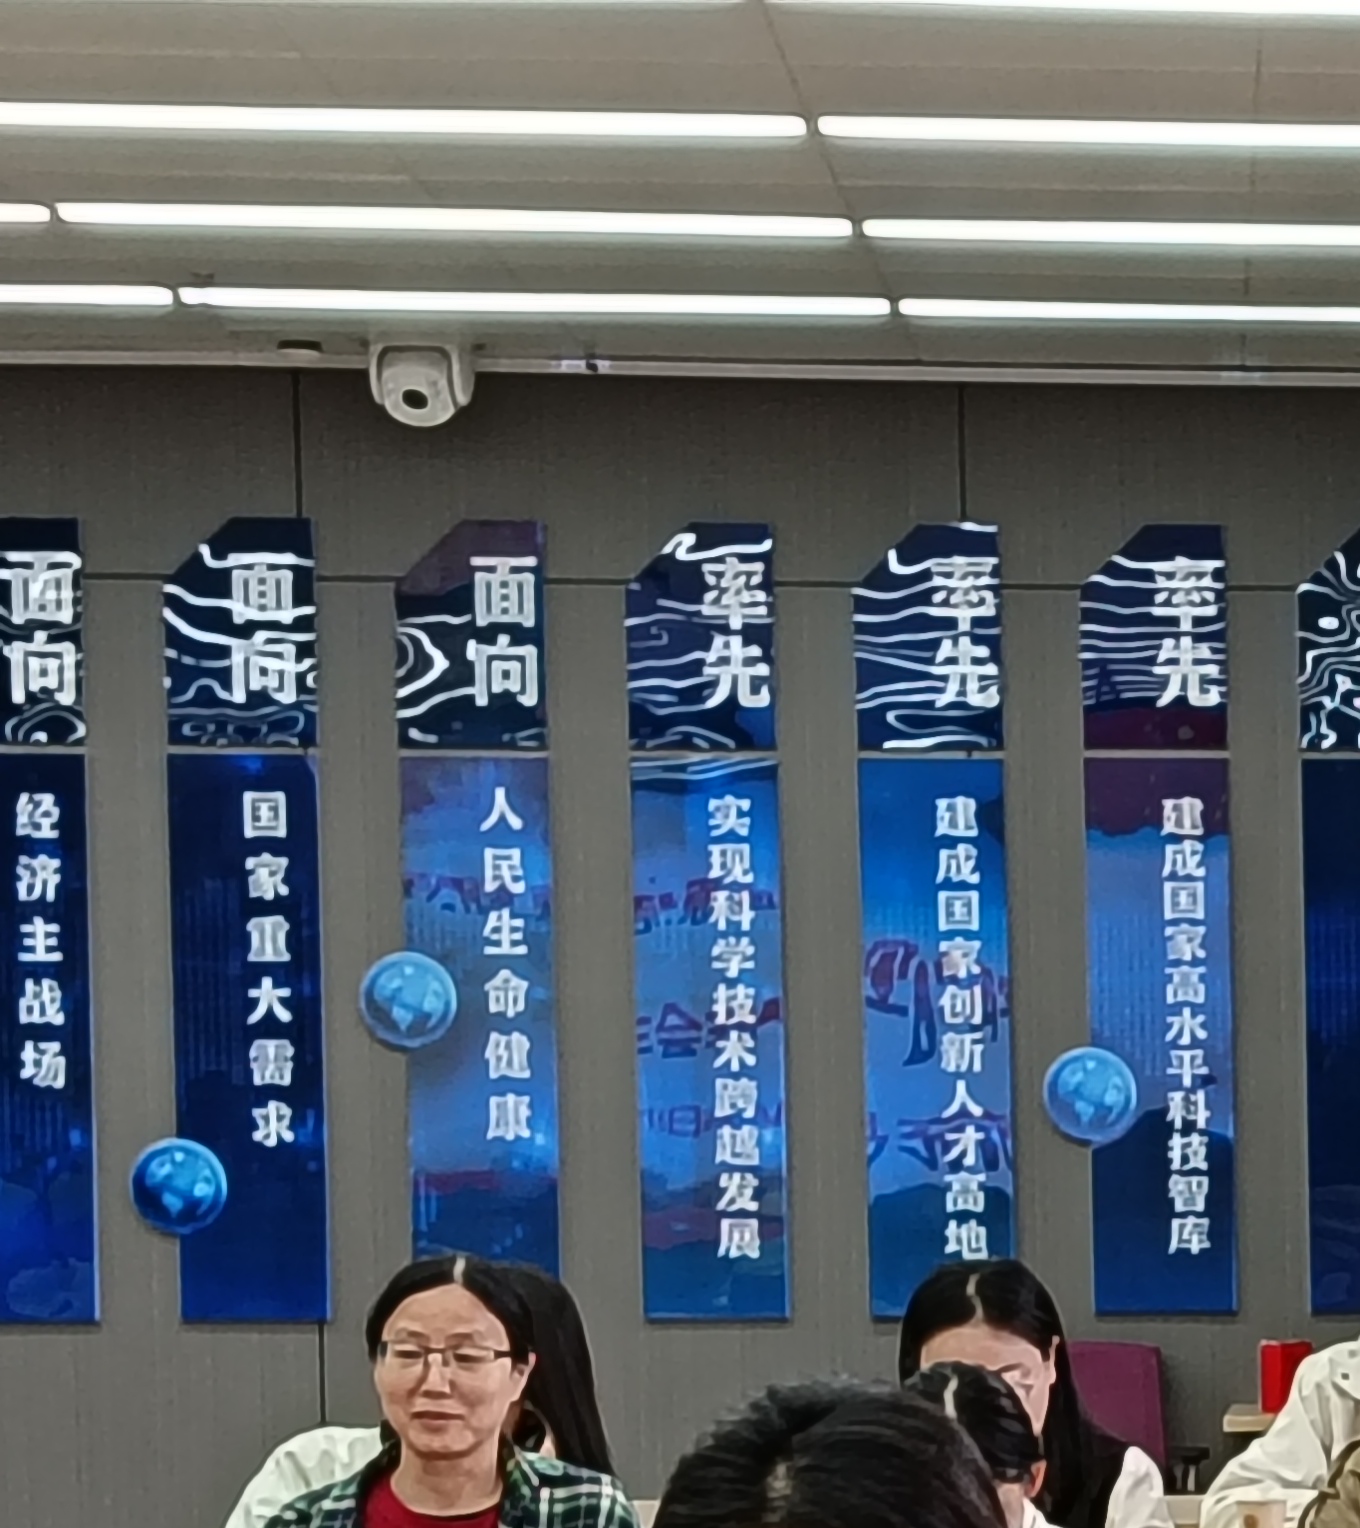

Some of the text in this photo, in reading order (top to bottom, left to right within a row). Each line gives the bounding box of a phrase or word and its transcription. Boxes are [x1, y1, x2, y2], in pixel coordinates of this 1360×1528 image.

[8, 552, 76, 706] 面向
[230, 558, 298, 705] 面向
[469, 556, 541, 708] 面向
[700, 555, 772, 708] 率先
[931, 555, 1000, 709] 率先
[1153, 555, 1227, 708] 率先
[15, 792, 66, 1090] 经济主战场
[242, 791, 295, 1147] 国家重大需求
[480, 786, 531, 1142] 人民生命健康
[707, 795, 761, 1260] 实现科学技术跨越发展
[935, 795, 989, 1260] 建成国家创新人才高地
[1161, 796, 1211, 1255] 建成国家高水平科技智库
